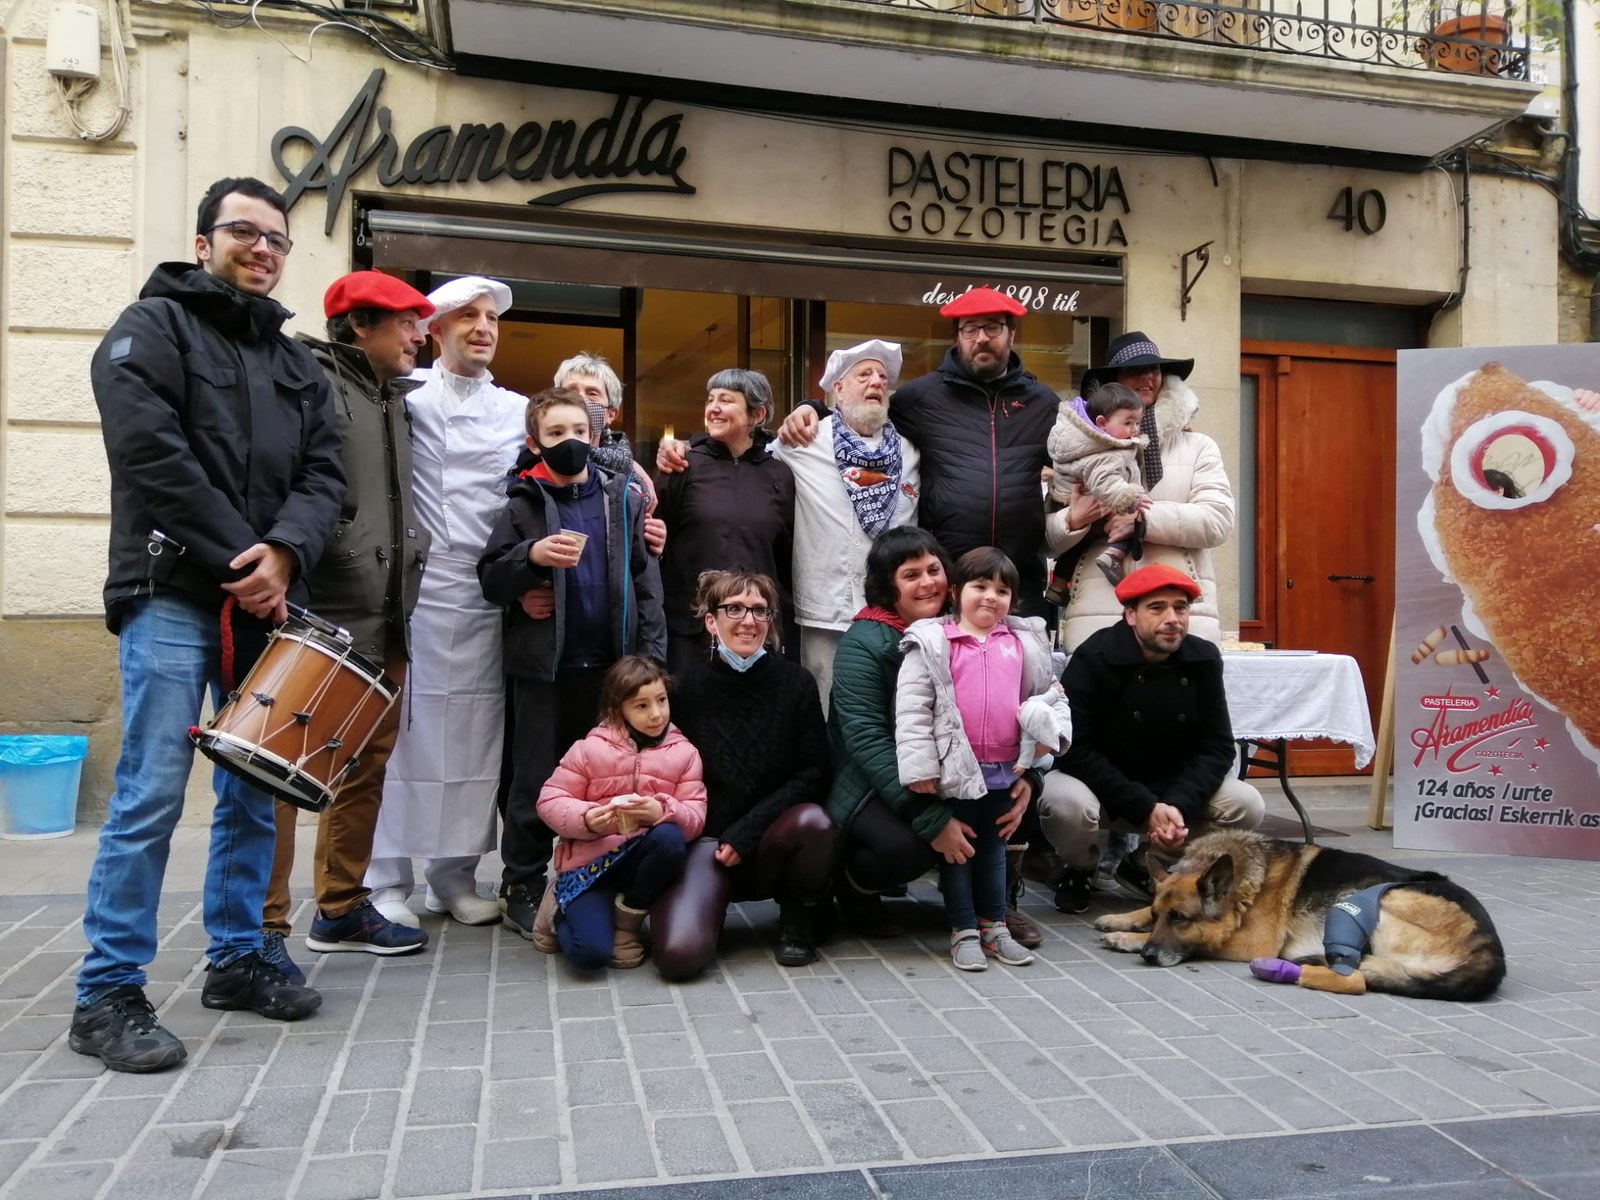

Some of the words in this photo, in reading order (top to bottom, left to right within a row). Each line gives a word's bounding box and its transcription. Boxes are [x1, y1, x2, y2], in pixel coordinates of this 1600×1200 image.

[888, 147, 1131, 215] PASTELERIA
[888, 201, 1129, 247] GOZOTEGIA
[1326, 186, 1387, 236] 40
[922, 282, 973, 305] des
[1052, 290, 1081, 312] tik
[850, 483, 897, 502] ozotegia
[863, 512, 886, 524] 2022
[1423, 698, 1476, 708] PASTELERIA
[1410, 682, 1538, 774] Aramendía
[1417, 779, 1449, 797] 124
[1452, 781, 1496, 799] años
[1414, 802, 1494, 822] ¡Gracias!
[1499, 805, 1575, 827] Eskerrik
[1579, 813, 1600, 828] as
